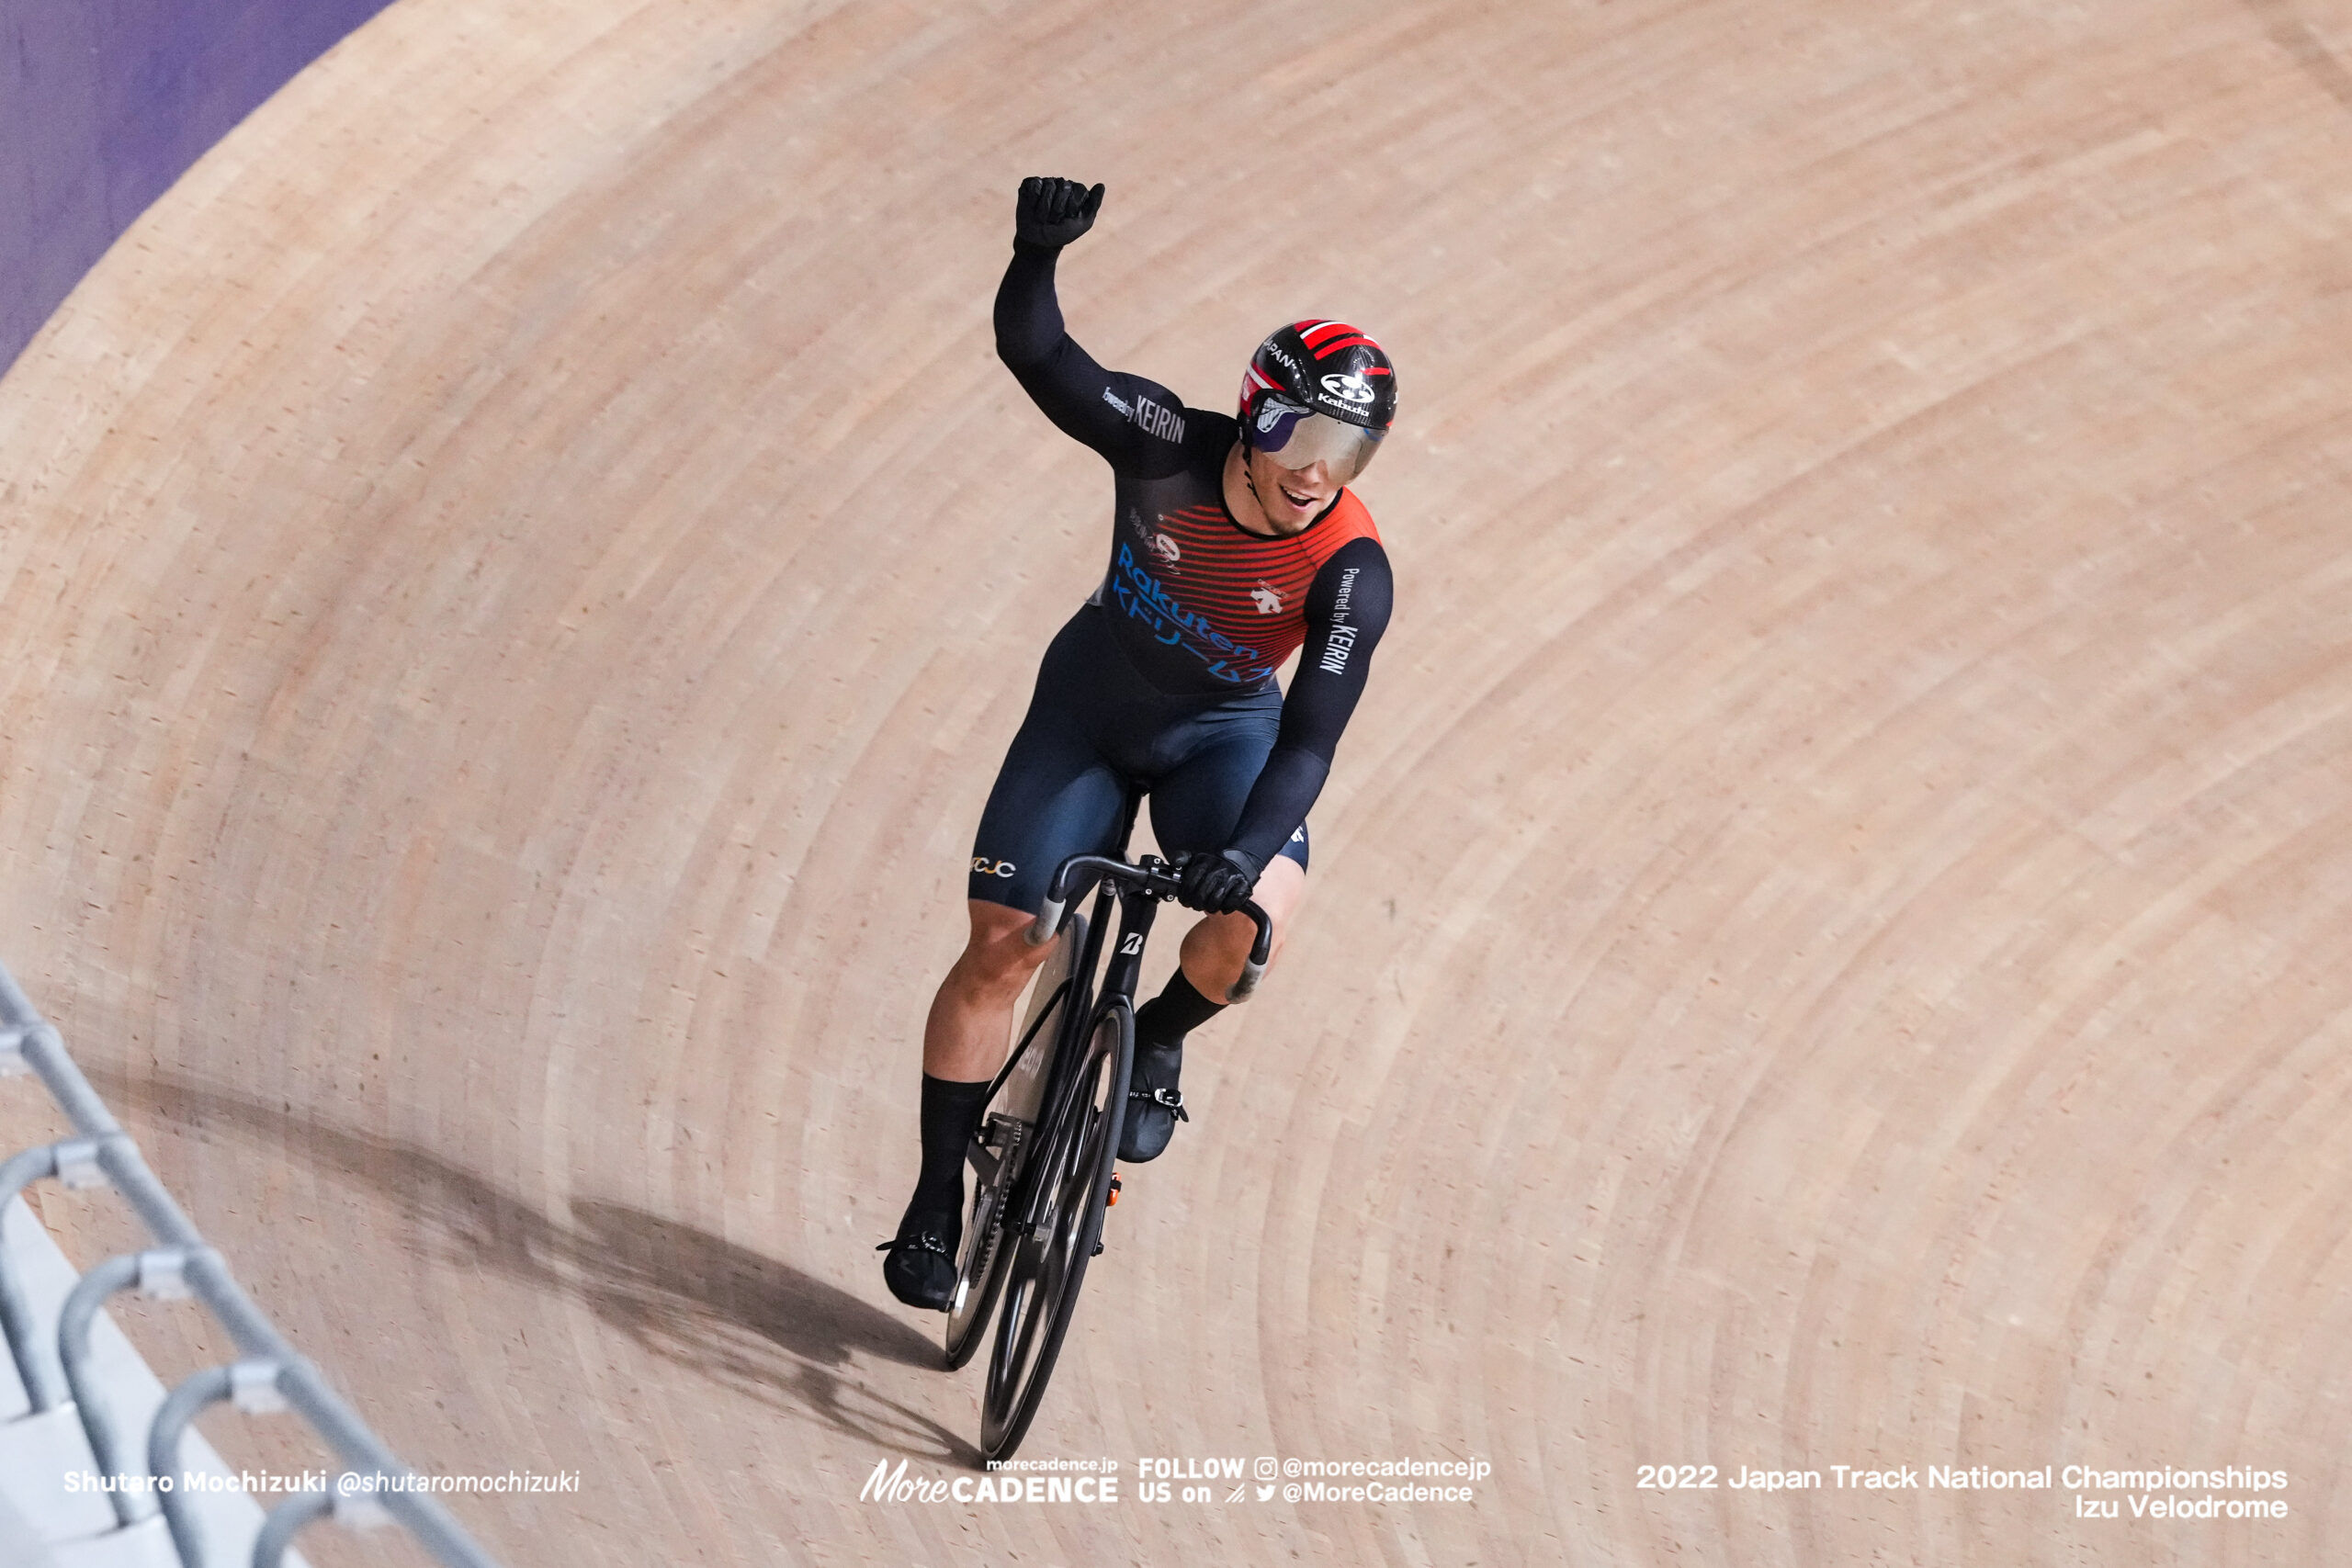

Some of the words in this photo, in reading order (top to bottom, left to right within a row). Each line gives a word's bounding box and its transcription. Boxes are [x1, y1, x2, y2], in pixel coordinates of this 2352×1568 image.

[1134, 394, 1185, 444] KEIRIN
[1317, 393, 1370, 417] Kabuto
[1118, 541, 1259, 660] Rakuten
[1334, 568, 1361, 610] Powered
[1329, 612, 1351, 624] by
[1319, 625, 1359, 675] KEIRIN
